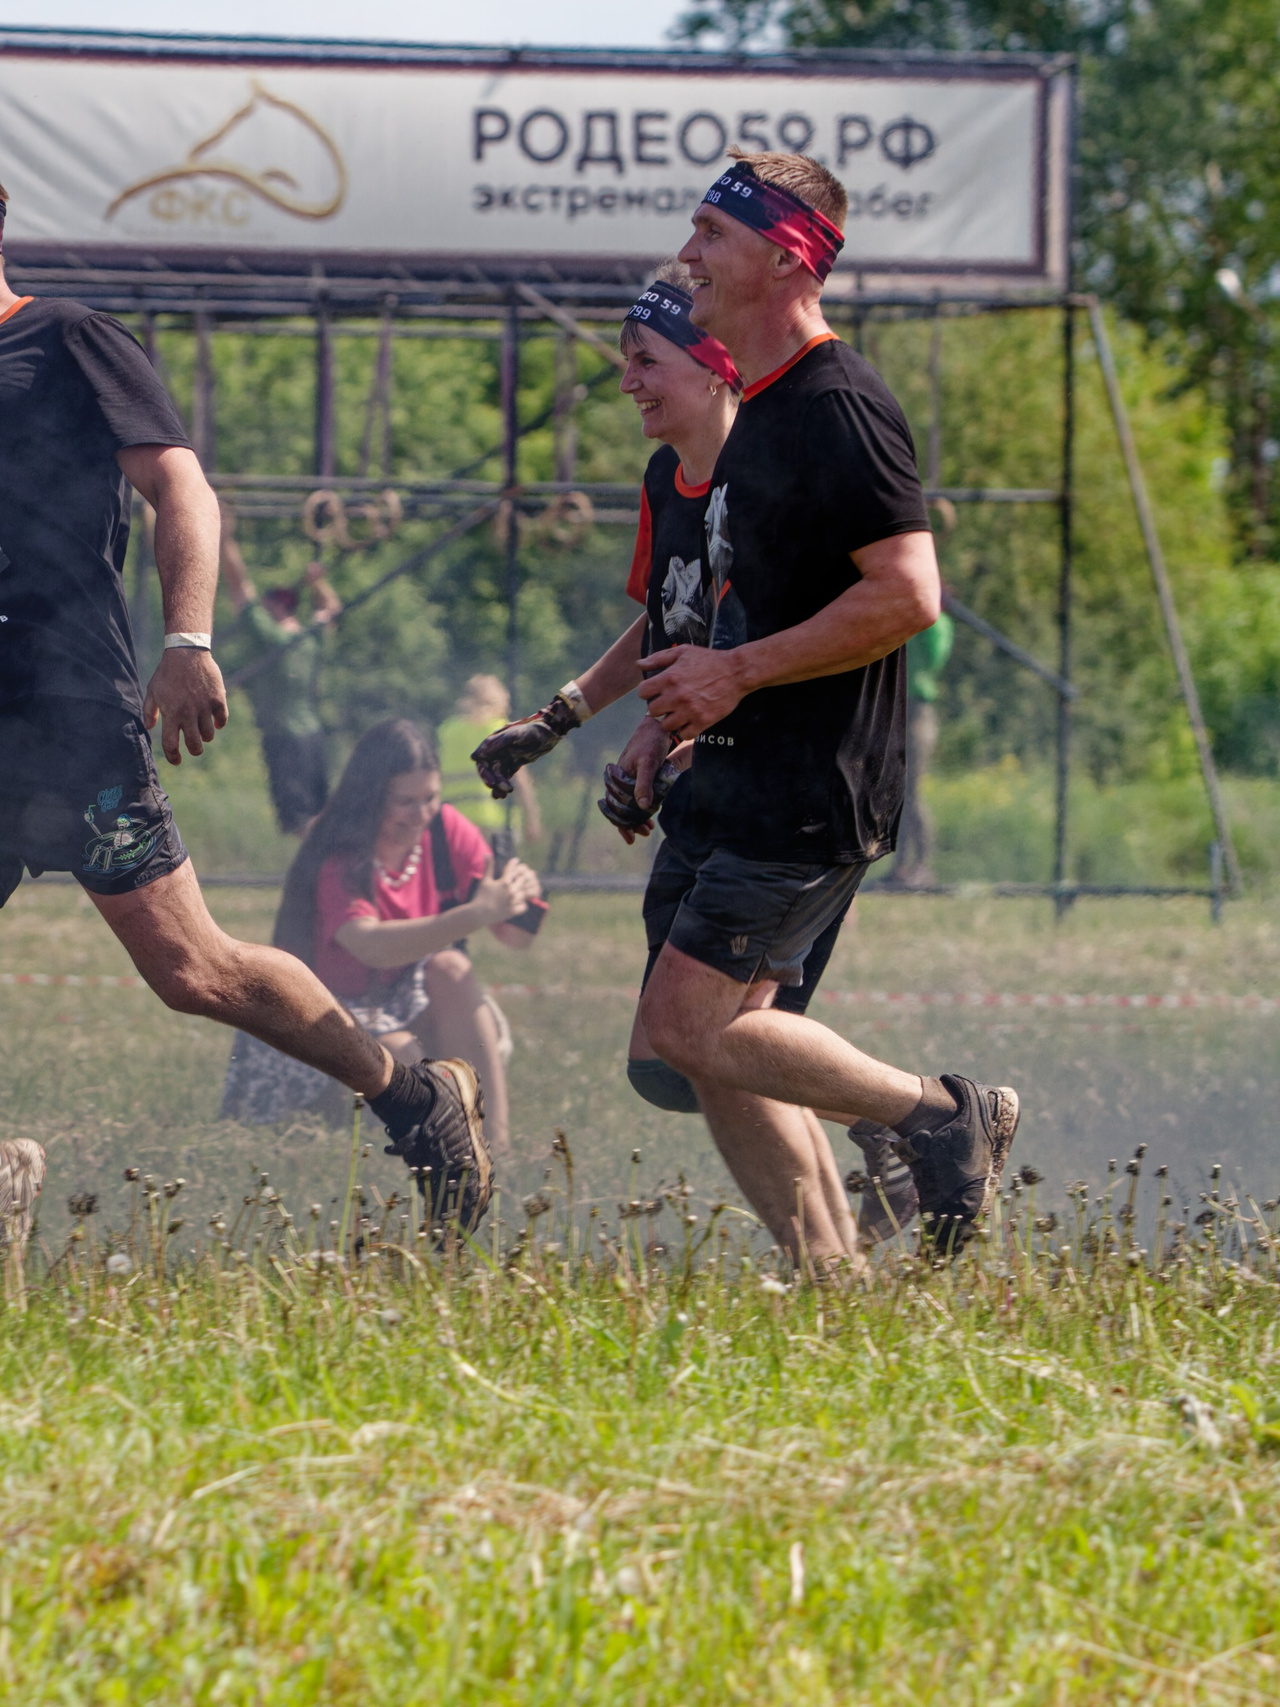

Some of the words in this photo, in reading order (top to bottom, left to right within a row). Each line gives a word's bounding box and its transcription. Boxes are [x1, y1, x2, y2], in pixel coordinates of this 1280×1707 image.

[473, 108, 937, 174] РОДЕО59.РФ
[730, 181, 753, 198] 59
[847, 183, 931, 219] абег
[660, 299, 681, 315] 59
